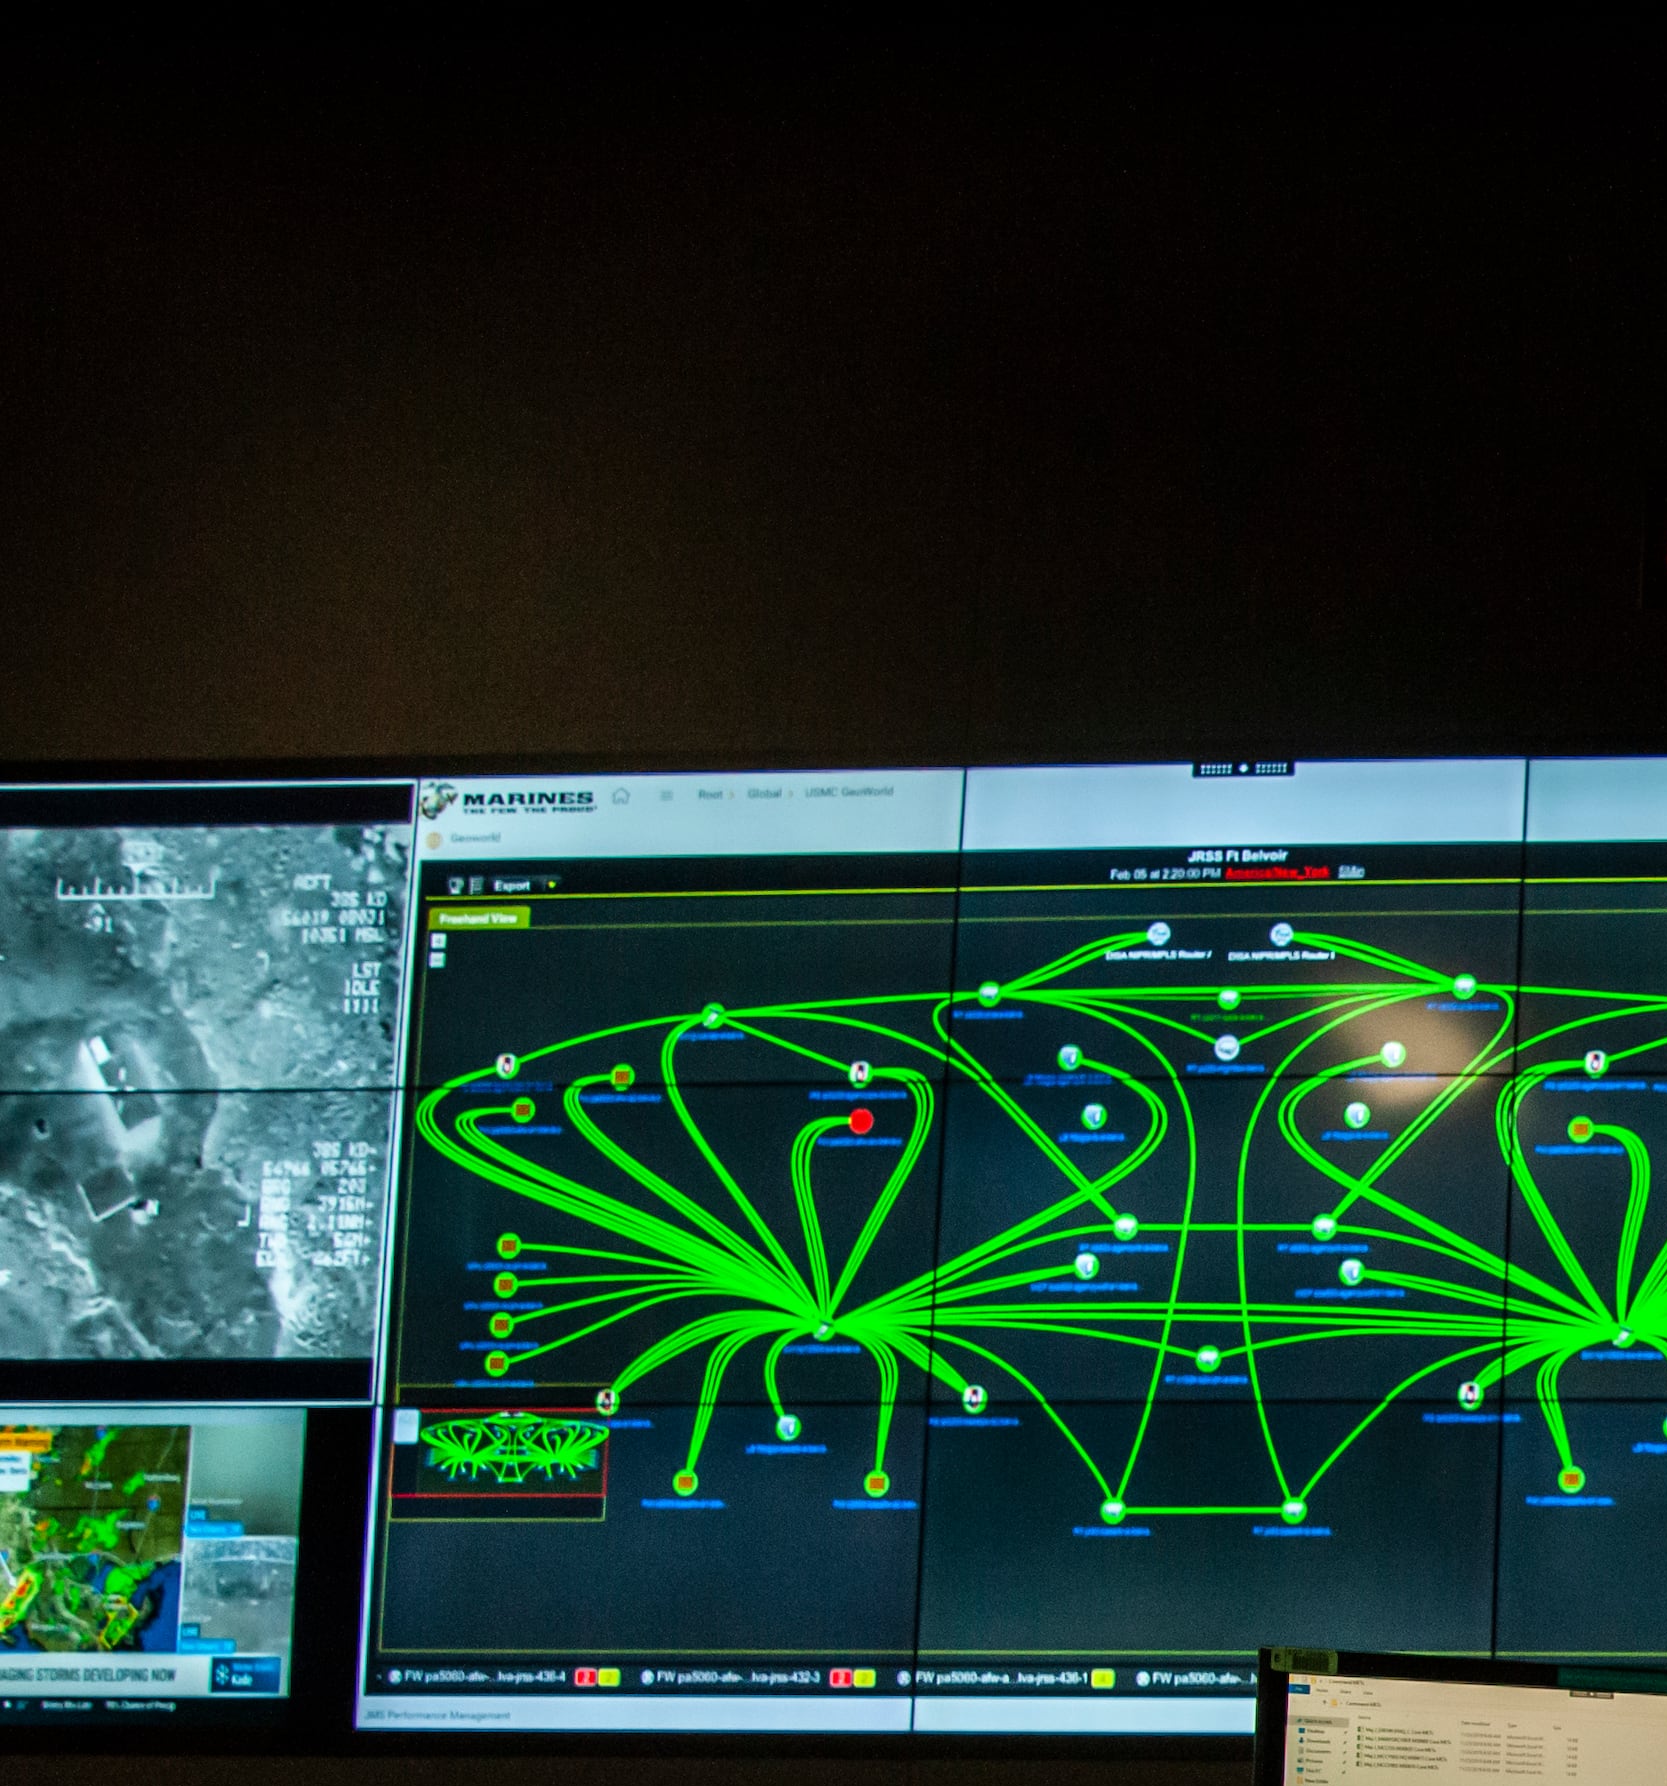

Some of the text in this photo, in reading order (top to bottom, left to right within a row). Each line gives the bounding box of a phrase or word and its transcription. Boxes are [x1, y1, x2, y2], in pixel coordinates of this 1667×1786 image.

[463, 791, 594, 805] MARINES
[748, 788, 782, 799] Global
[805, 787, 838, 799] USMC
[463, 806, 487, 814] THE
[524, 806, 547, 814] THE
[1187, 849, 1289, 863] JRSS Ft Belvoir
[1110, 868, 1131, 880] Feb
[1202, 867, 1222, 879] PM
[493, 880, 531, 893] Export
[491, 912, 517, 925] View
[0, 1667, 177, 1682] AGING STORMS DEVELOPING NOW
